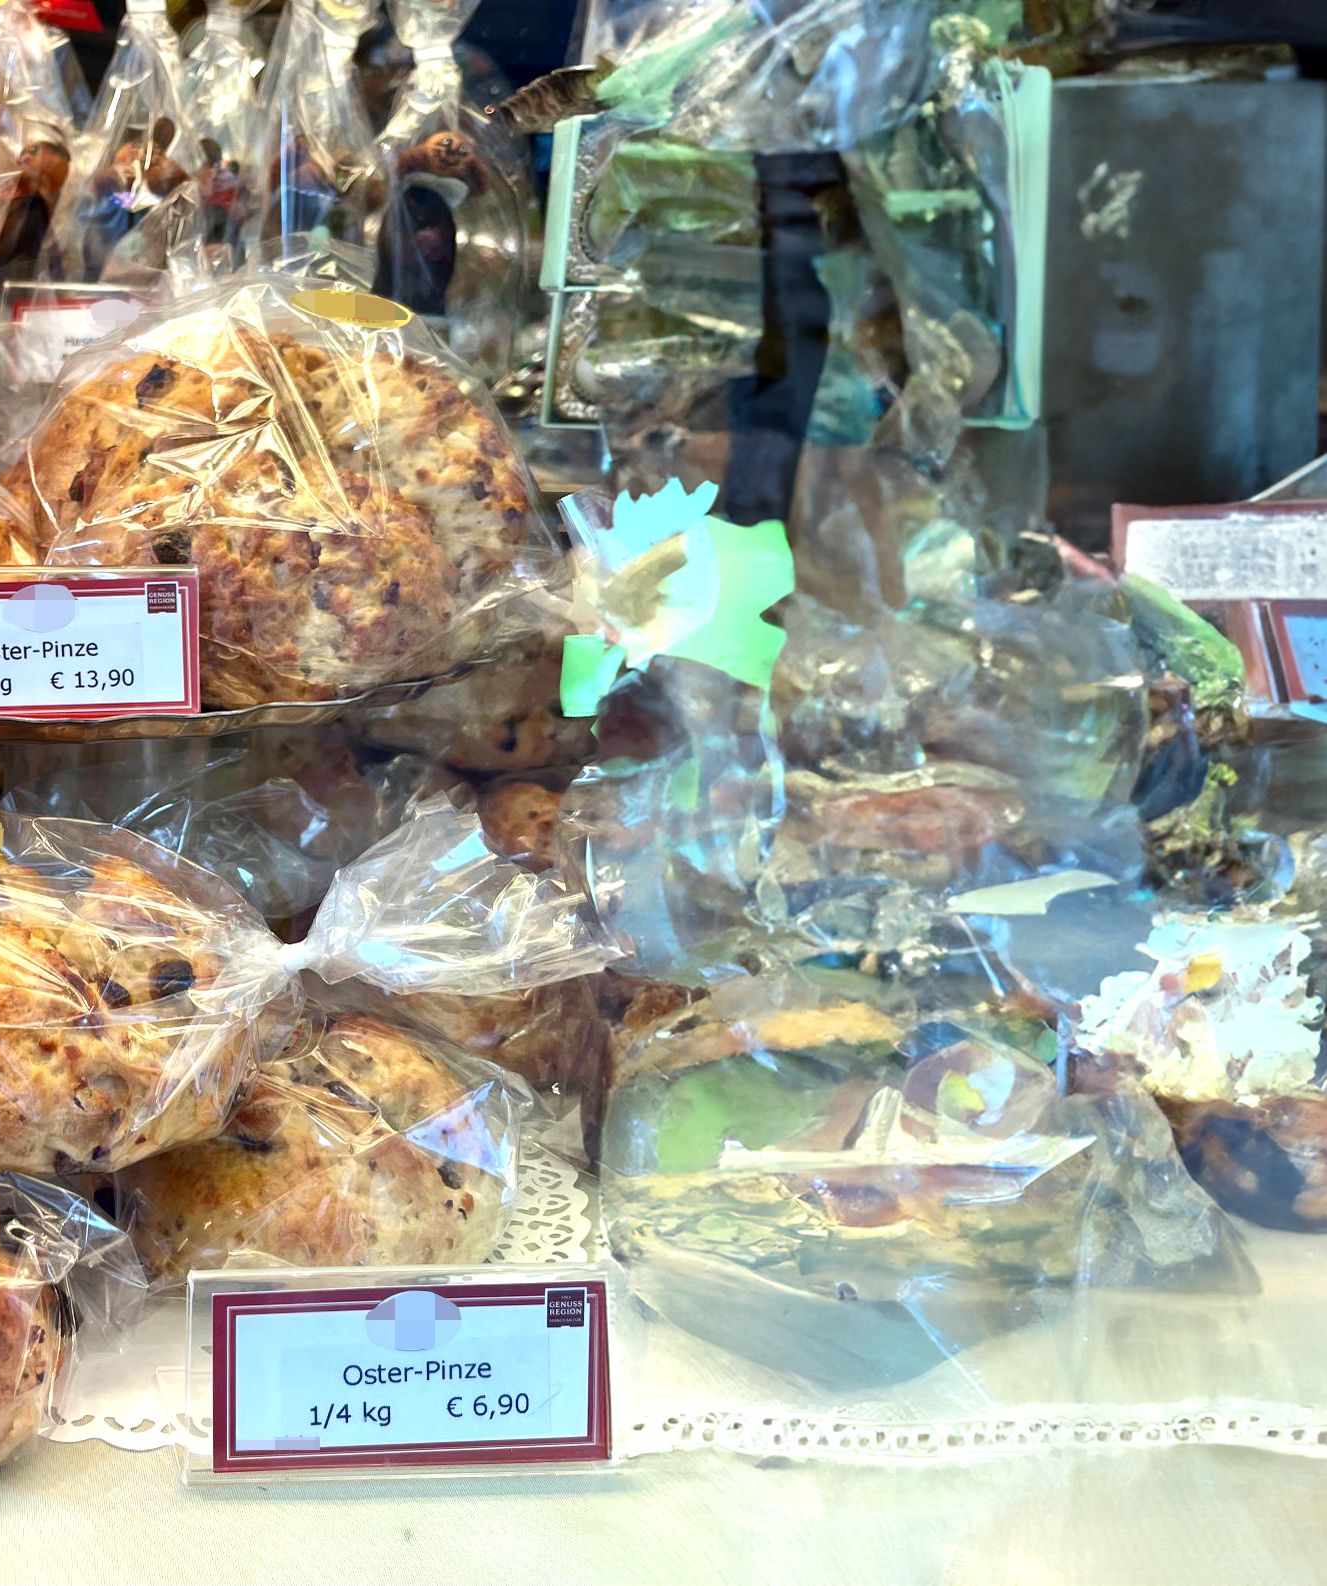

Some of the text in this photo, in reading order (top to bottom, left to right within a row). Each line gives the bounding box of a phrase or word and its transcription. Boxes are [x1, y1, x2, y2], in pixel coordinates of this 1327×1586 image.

[50, 671, 65, 690] €
[74, 668, 135, 691] 13,90
[548, 1300, 583, 1308] GENUSS
[548, 1307, 582, 1316] REGION
[342, 1359, 492, 1386] Oster-Pinze
[309, 1392, 530, 1429] 1/4 kg € 6,90
